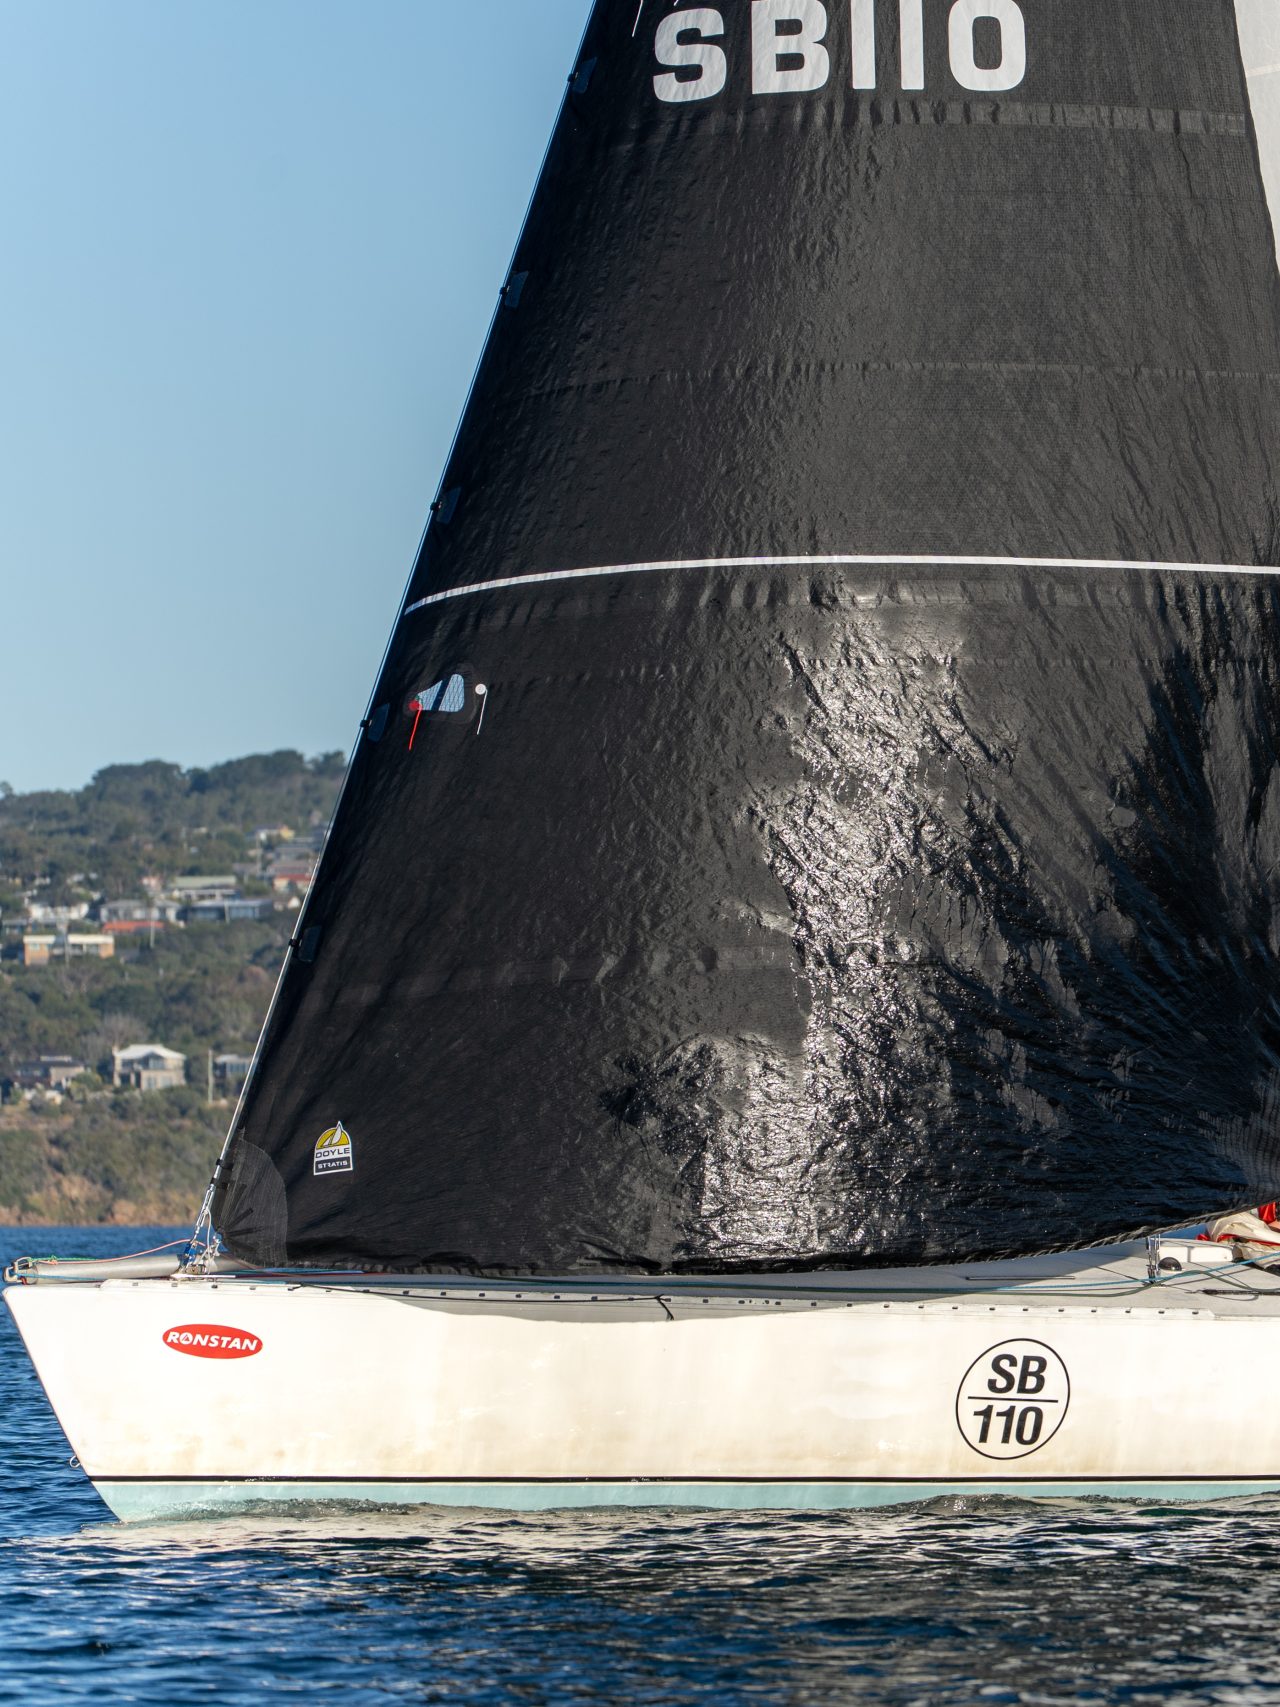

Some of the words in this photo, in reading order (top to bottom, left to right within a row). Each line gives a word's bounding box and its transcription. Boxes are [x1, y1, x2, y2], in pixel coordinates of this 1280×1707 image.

[653, 0, 1026, 102] SB110
[315, 1147, 351, 1159] DOYLE
[317, 1160, 348, 1170] STRATIS
[166, 1331, 258, 1351] RONSTAN
[987, 1353, 1048, 1394] SB
[973, 1404, 1044, 1446] 110
